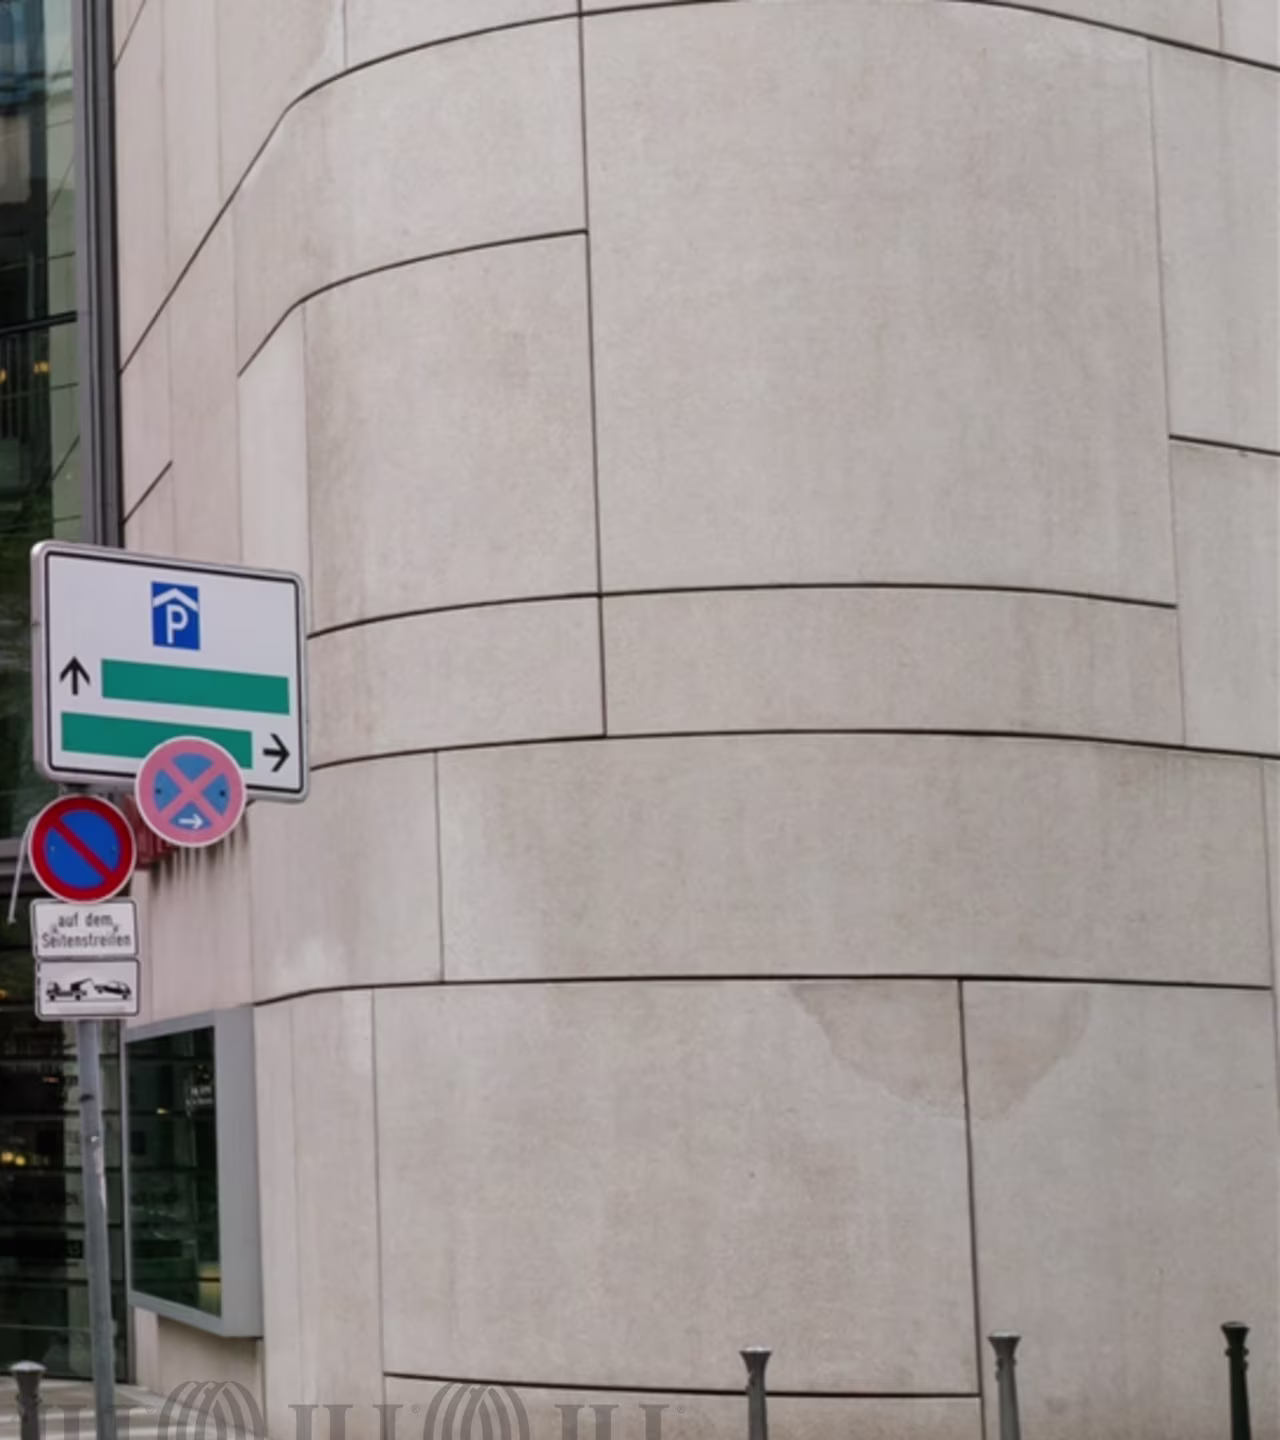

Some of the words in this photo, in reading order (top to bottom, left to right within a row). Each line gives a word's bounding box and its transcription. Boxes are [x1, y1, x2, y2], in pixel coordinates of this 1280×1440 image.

[166, 604, 188, 645] P
[58, 912, 79, 928] auf
[85, 912, 113, 928] dem
[42, 932, 131, 949] Seitenstreifen
